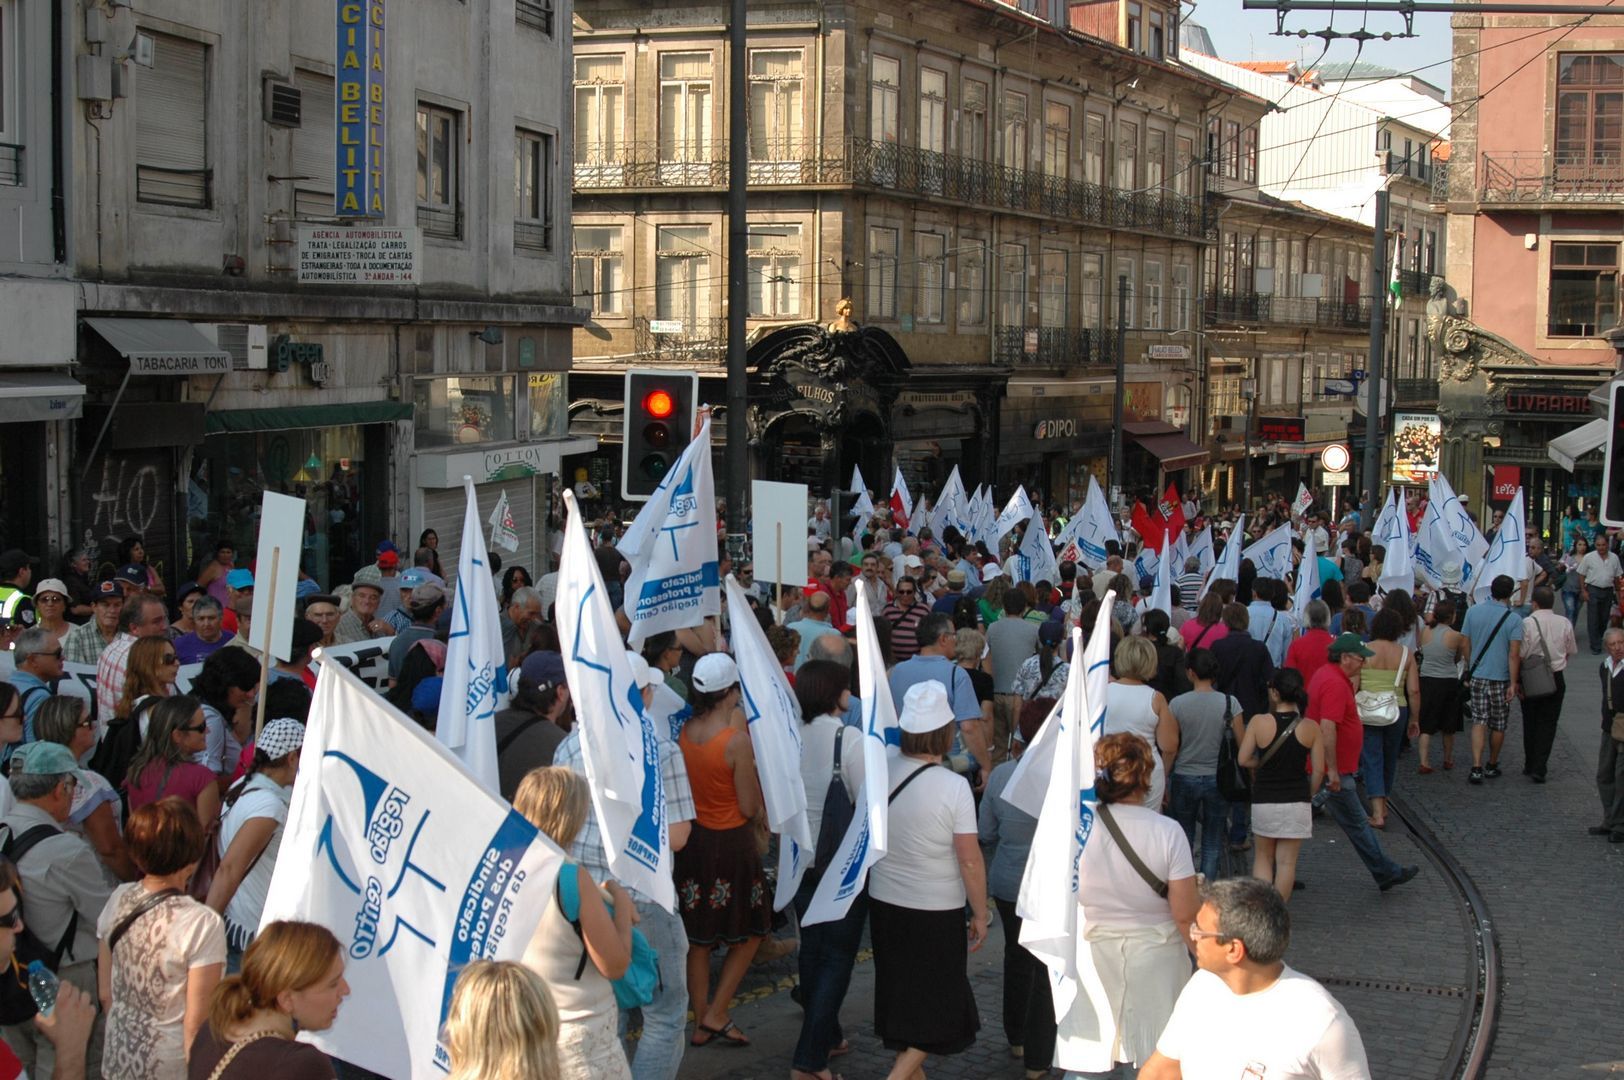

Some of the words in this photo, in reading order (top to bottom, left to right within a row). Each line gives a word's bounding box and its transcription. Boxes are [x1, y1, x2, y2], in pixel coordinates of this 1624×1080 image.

[341, 0, 361, 70] CIA
[341, 82, 361, 211] BELITA
[371, 83, 384, 212] BELITA
[312, 230, 340, 239] AGÊNCIA
[345, 230, 403, 239] AUTOMOBILÍSTICA
[381, 241, 407, 249] CARROS
[301, 251, 309, 260] DE
[379, 251, 387, 260] DE
[389, 251, 413, 260] CARTAS
[363, 261, 367, 270] A
[369, 261, 413, 271] DOCUMENTAÇÃO
[301, 271, 357, 280] AUTOMOBILÍSTICA
[373, 272, 395, 280] ANDAR
[401, 272, 412, 280] 144
[137, 356, 199, 372] TABACARIA
[204, 356, 228, 370] TONI
[797, 385, 835, 404] FILHOS
[49, 399, 67, 410] blue
[1047, 418, 1078, 439] DIPOL
[485, 448, 541, 472] COTTON
